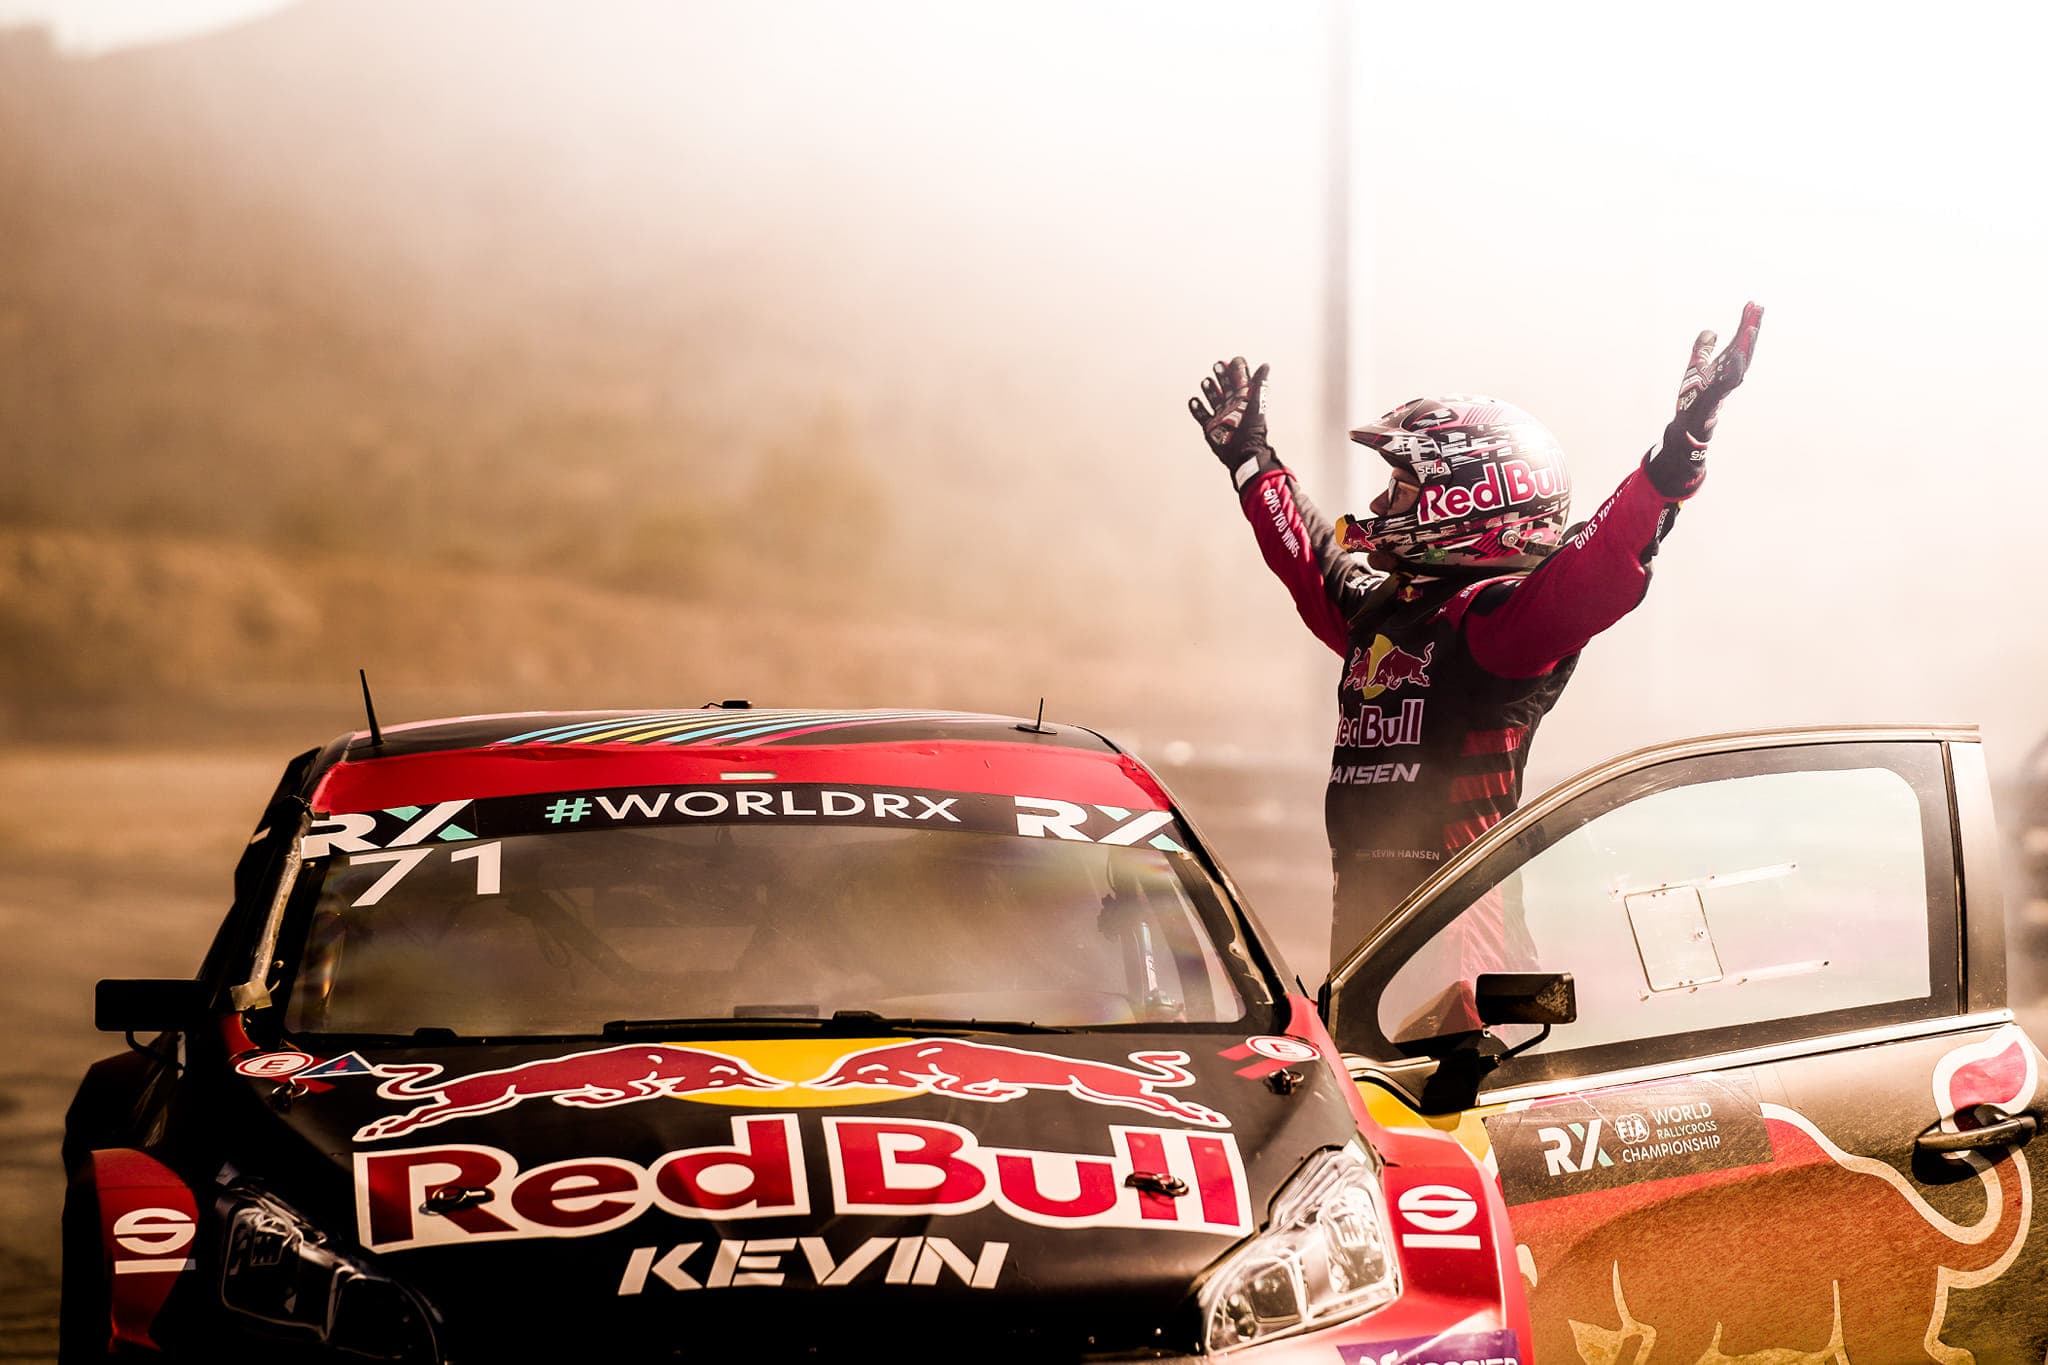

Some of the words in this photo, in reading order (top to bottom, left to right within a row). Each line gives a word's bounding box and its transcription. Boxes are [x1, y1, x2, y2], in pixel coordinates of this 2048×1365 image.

[1416, 462, 1505, 526] Red
[1501, 447, 1570, 506] Bull
[1418, 460, 1446, 475] Stilo
[1263, 488, 1281, 514] GIVES
[1272, 509, 1289, 533] YOU
[1281, 527, 1300, 558] WINGS
[1574, 519, 1598, 550] GIVES
[1357, 698, 1425, 748] Bull
[1329, 763, 1421, 785] ANSEN
[300, 798, 479, 860] RX
[543, 789, 962, 824] #WORLDRX
[1013, 794, 1188, 853] RX
[348, 841, 501, 908] 71
[1371, 848, 1395, 859] KEVIN
[1397, 850, 1440, 861] HANSEN
[1651, 1102, 1713, 1127] WORLD
[1656, 1119, 1718, 1140] RALLYCROSS
[1537, 1118, 1615, 1177] RX
[1622, 1134, 1722, 1164] CHAMPIONSHIP
[352, 1112, 811, 1255] Red
[821, 1115, 1255, 1238] Bull
[617, 1236, 1010, 1297] KEVIN
